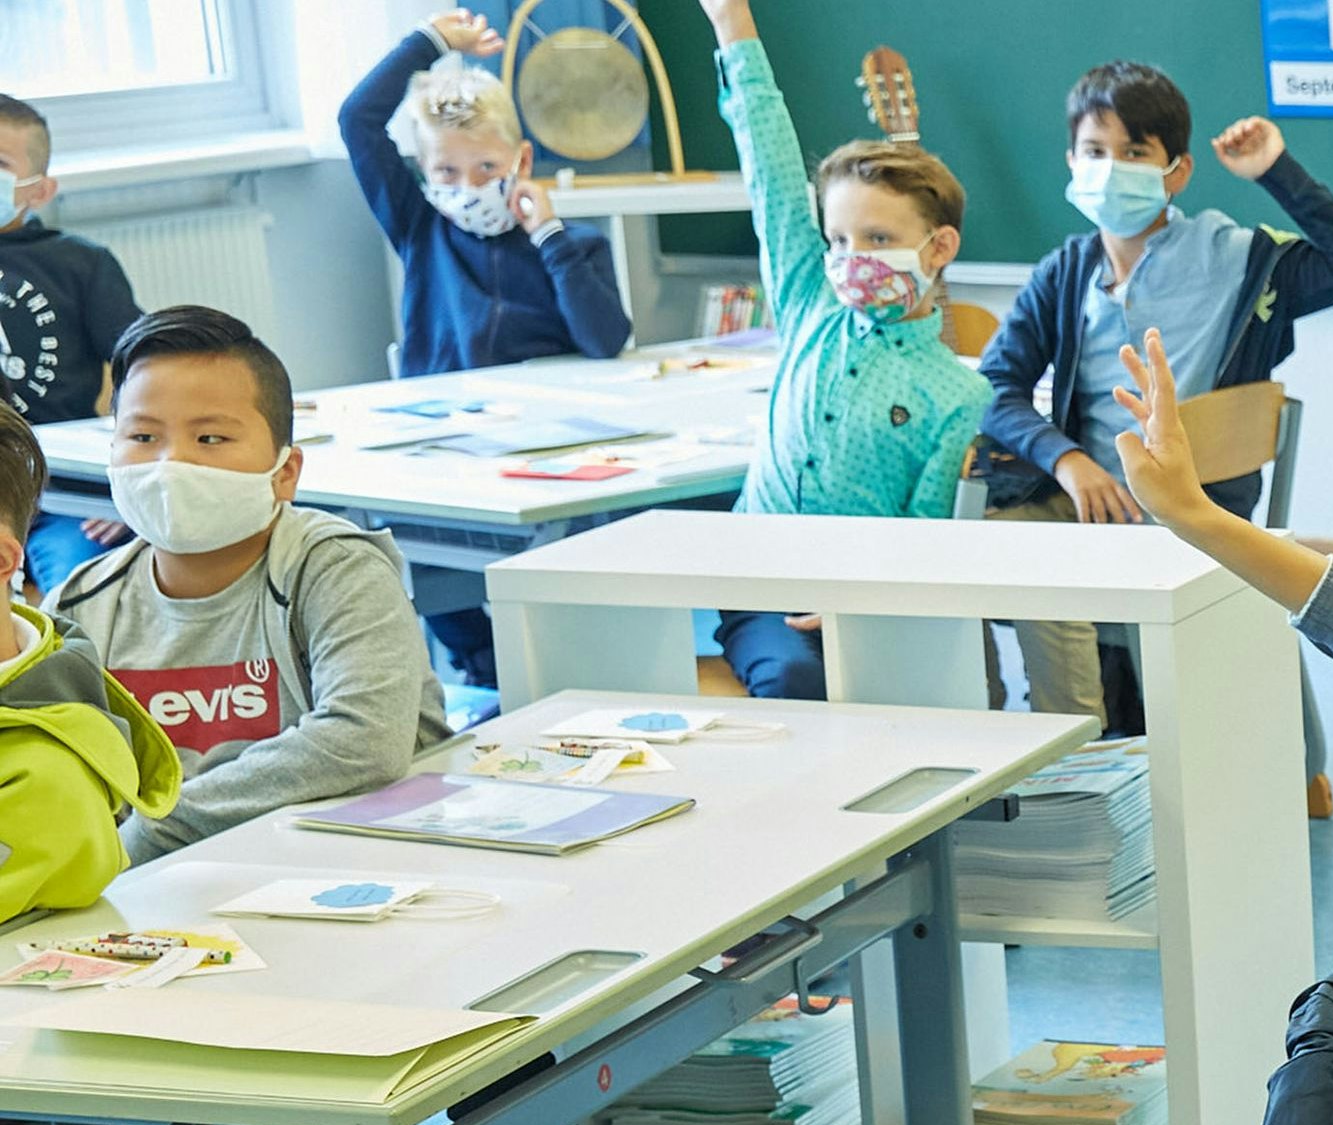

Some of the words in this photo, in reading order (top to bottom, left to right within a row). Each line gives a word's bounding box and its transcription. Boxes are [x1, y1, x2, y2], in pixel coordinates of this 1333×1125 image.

[16, 279, 57, 328] THE
[28, 336, 58, 397] BEST
[130, 684, 268, 726] evi's
